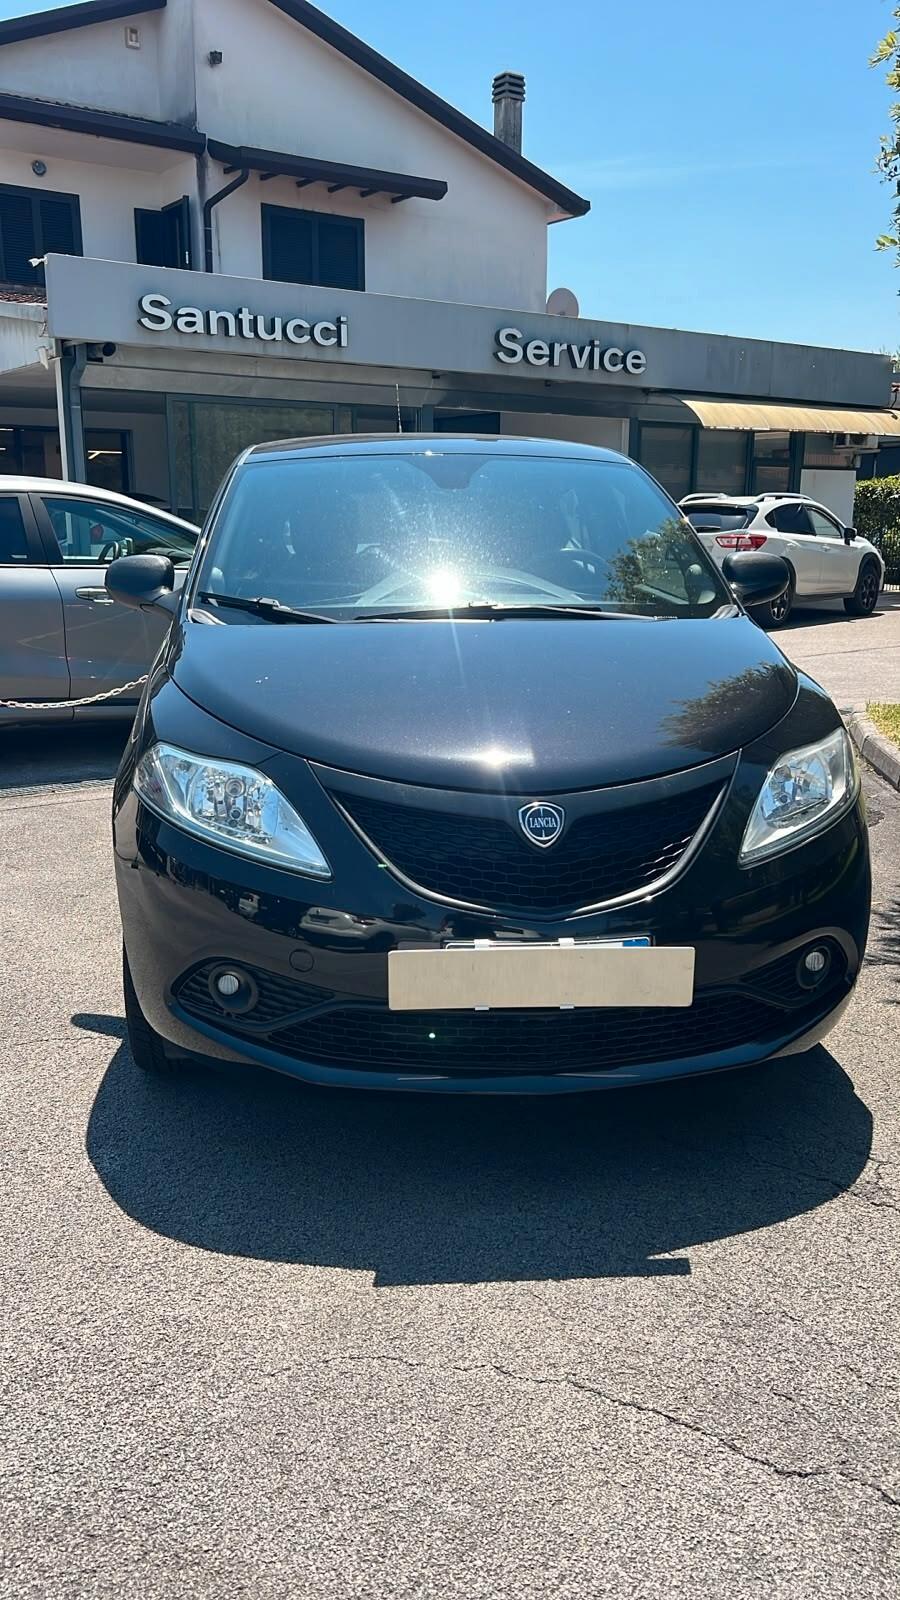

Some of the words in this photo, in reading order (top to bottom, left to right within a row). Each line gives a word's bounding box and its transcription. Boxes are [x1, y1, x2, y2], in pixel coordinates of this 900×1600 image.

[139, 293, 348, 347] Santucci
[496, 327, 647, 374] Service
[529, 817, 557, 828] LANCIA
